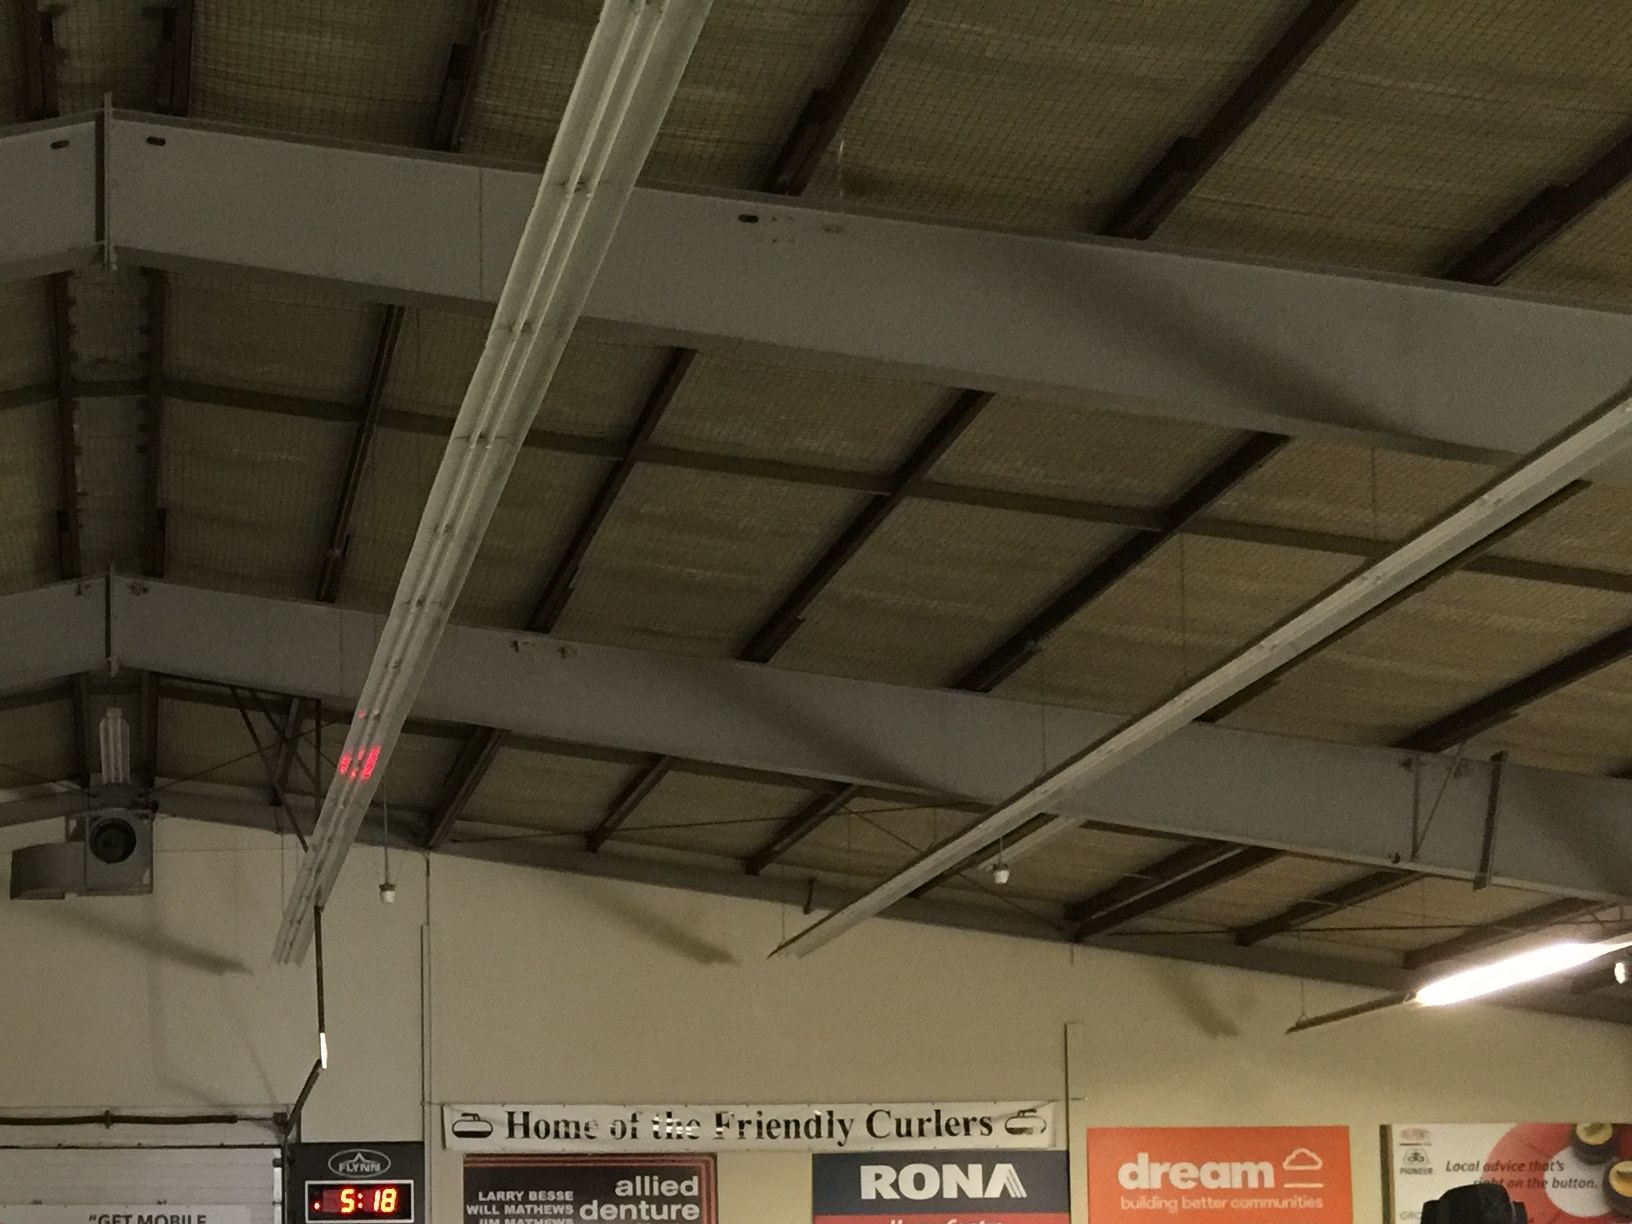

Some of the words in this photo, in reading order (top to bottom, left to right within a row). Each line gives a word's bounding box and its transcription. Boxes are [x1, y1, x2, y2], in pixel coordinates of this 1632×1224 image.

[505, 1110, 599, 1140] Home
[610, 1110, 643, 1140] of
[651, 1111, 701, 1140] the
[713, 1109, 855, 1147] Friendly
[865, 1108, 993, 1139] Curlers
[338, 1163, 380, 1172] FLYNN
[1117, 1152, 1275, 1190] dream
[1445, 1160, 1480, 1172] Local
[1483, 1160, 1526, 1172] advice
[1529, 1160, 1564, 1172] that's
[615, 1175, 699, 1197] allied
[860, 1162, 1027, 1200] RONA
[1508, 1180, 1523, 1189] on
[1527, 1177, 1548, 1188] the
[1551, 1177, 1598, 1189] button.
[341, 1188, 397, 1213] 5:18
[478, 1191, 524, 1201] LARRY
[528, 1191, 574, 1201] BESSE
[1120, 1197, 1178, 1214] building
[1182, 1197, 1229, 1209] better
[1231, 1195, 1323, 1209] communities
[466, 1205, 500, 1215] WILL
[504, 1205, 574, 1215] MATHEWS
[579, 1200, 700, 1221] denture
